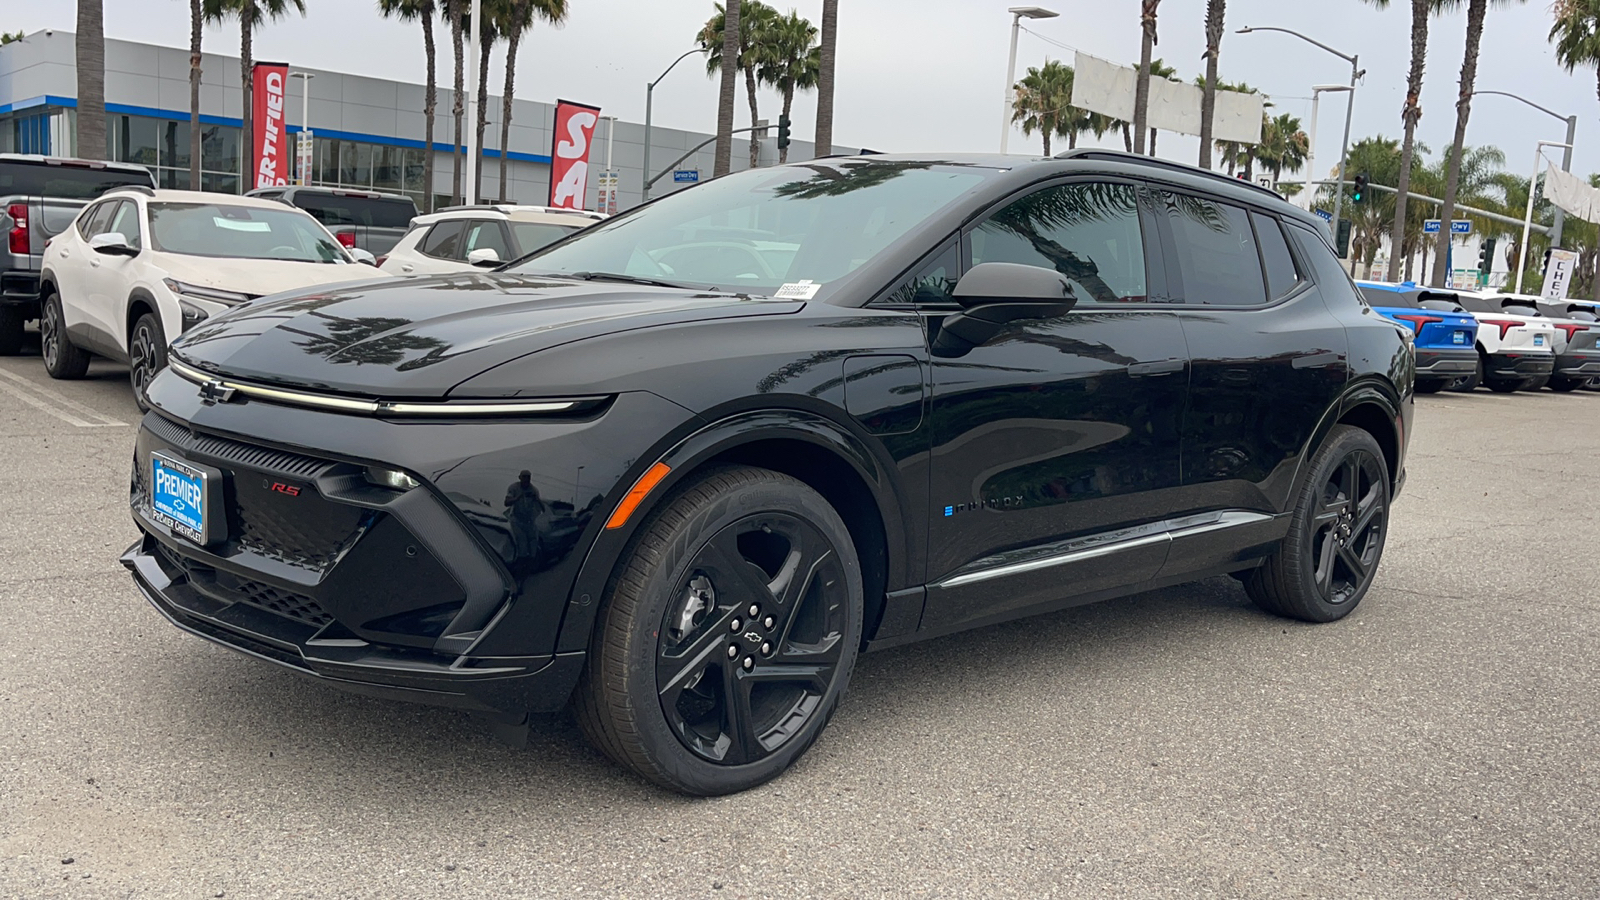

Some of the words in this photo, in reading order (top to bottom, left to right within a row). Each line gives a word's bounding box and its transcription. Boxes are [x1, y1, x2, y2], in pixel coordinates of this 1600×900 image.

[257, 71, 283, 188] ERTIFIED
[553, 111, 597, 210] SA
[1426, 222, 1441, 230] Serv
[1452, 222, 1468, 231] Dwy
[156, 468, 202, 515] PREMIER
[271, 482, 301, 497] RS
[153, 511, 174, 528] PREMIER
[175, 521, 202, 543] CHEVROLET
